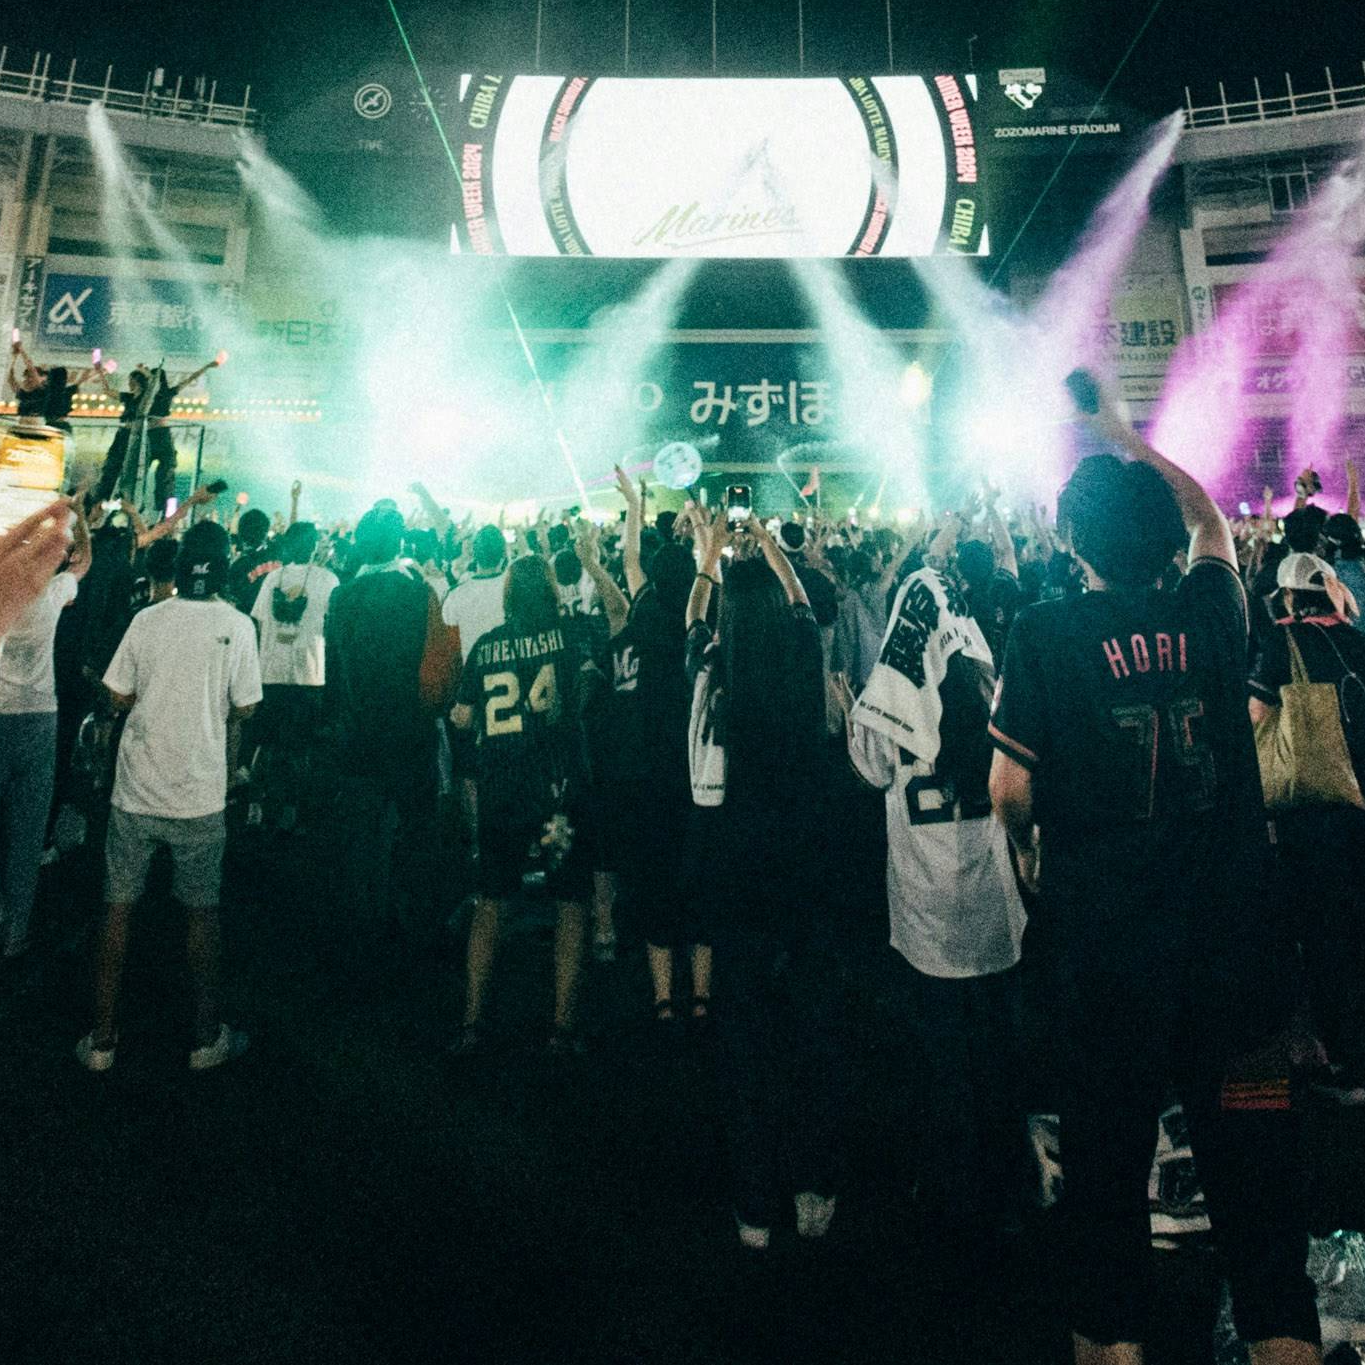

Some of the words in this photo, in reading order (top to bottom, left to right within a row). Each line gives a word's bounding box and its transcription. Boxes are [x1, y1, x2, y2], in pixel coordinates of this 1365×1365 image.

[469, 85, 499, 129] CHIBA
[862, 96, 885, 127] LOTTE
[948, 109, 974, 147] WEEK
[1070, 122, 1121, 135] STADIUM
[462, 143, 483, 179] 2024
[955, 147, 977, 183] 2024
[949, 198, 975, 245] CHIBA
[1102, 631, 1188, 680] HORI
[482, 662, 561, 737] 24
